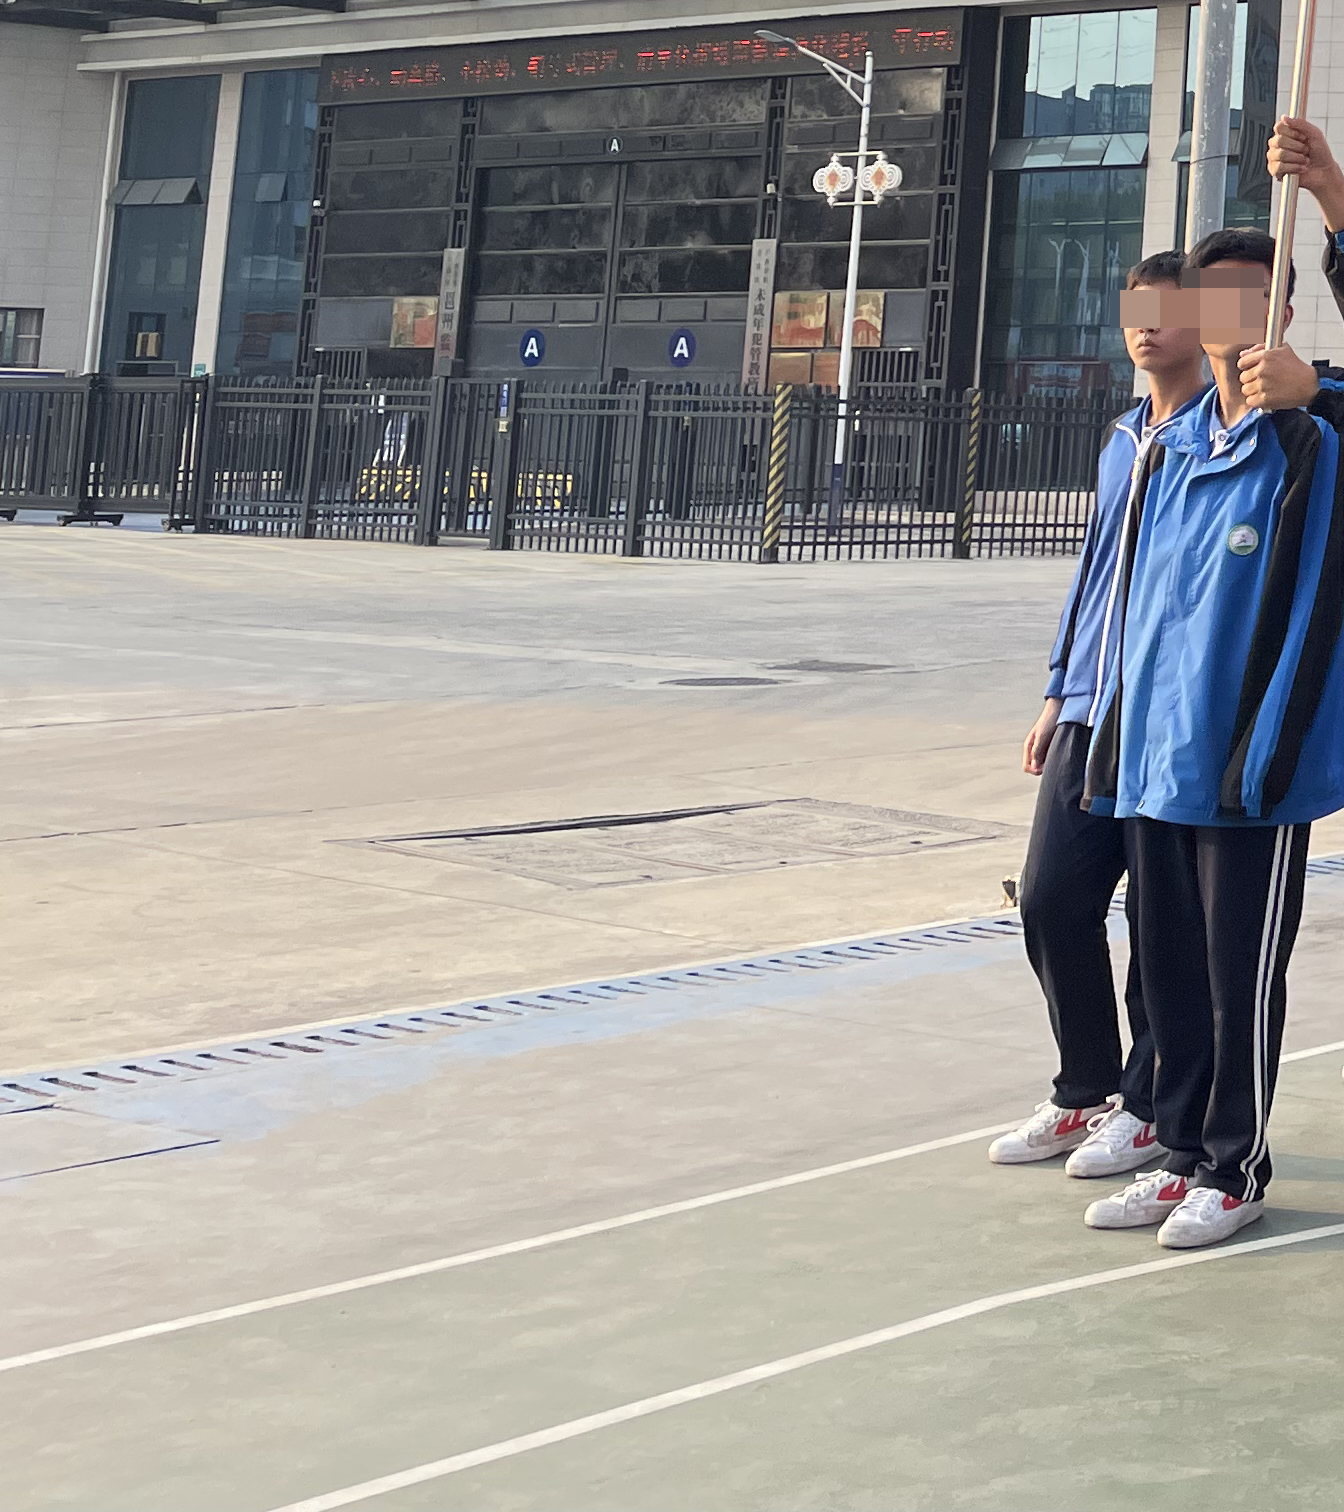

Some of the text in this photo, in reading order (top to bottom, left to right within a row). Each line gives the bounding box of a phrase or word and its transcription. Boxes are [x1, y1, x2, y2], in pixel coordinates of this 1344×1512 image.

[610, 138, 619, 152] A
[524, 337, 539, 358] A
[673, 337, 690, 358] A
